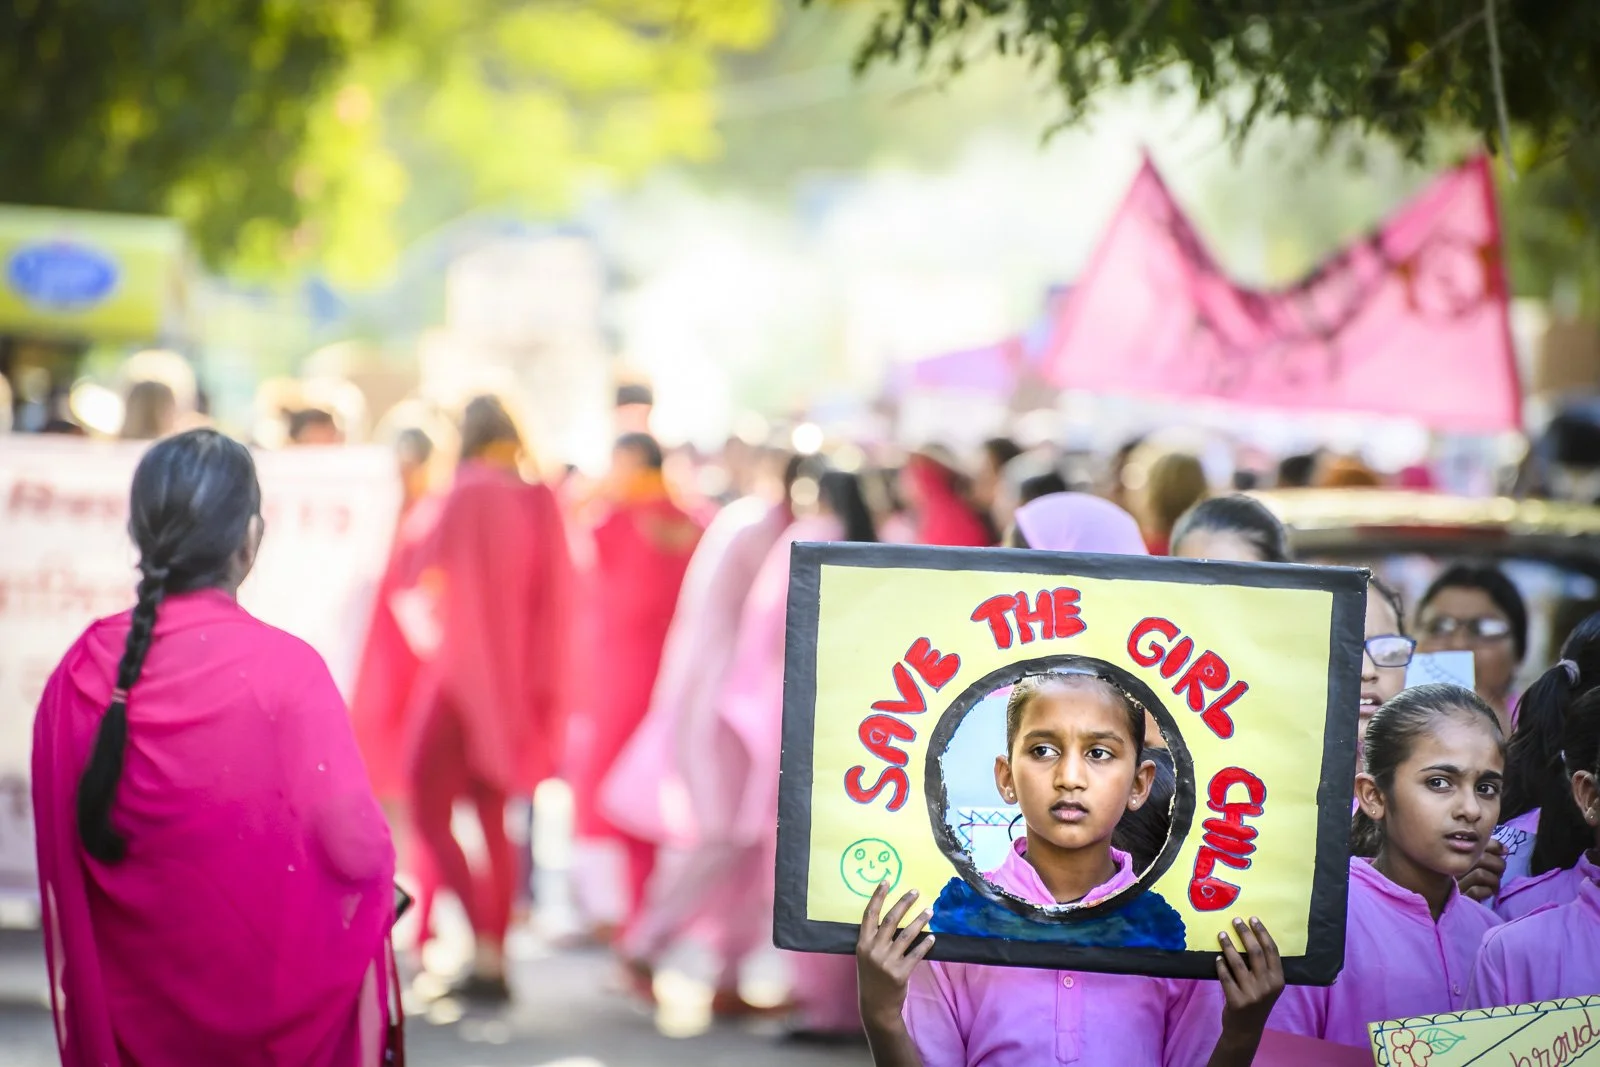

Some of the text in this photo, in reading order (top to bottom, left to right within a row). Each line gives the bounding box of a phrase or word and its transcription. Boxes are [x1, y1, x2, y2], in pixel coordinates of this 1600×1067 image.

[844, 586, 1268, 912] SAVE THE GIRL CHILD
